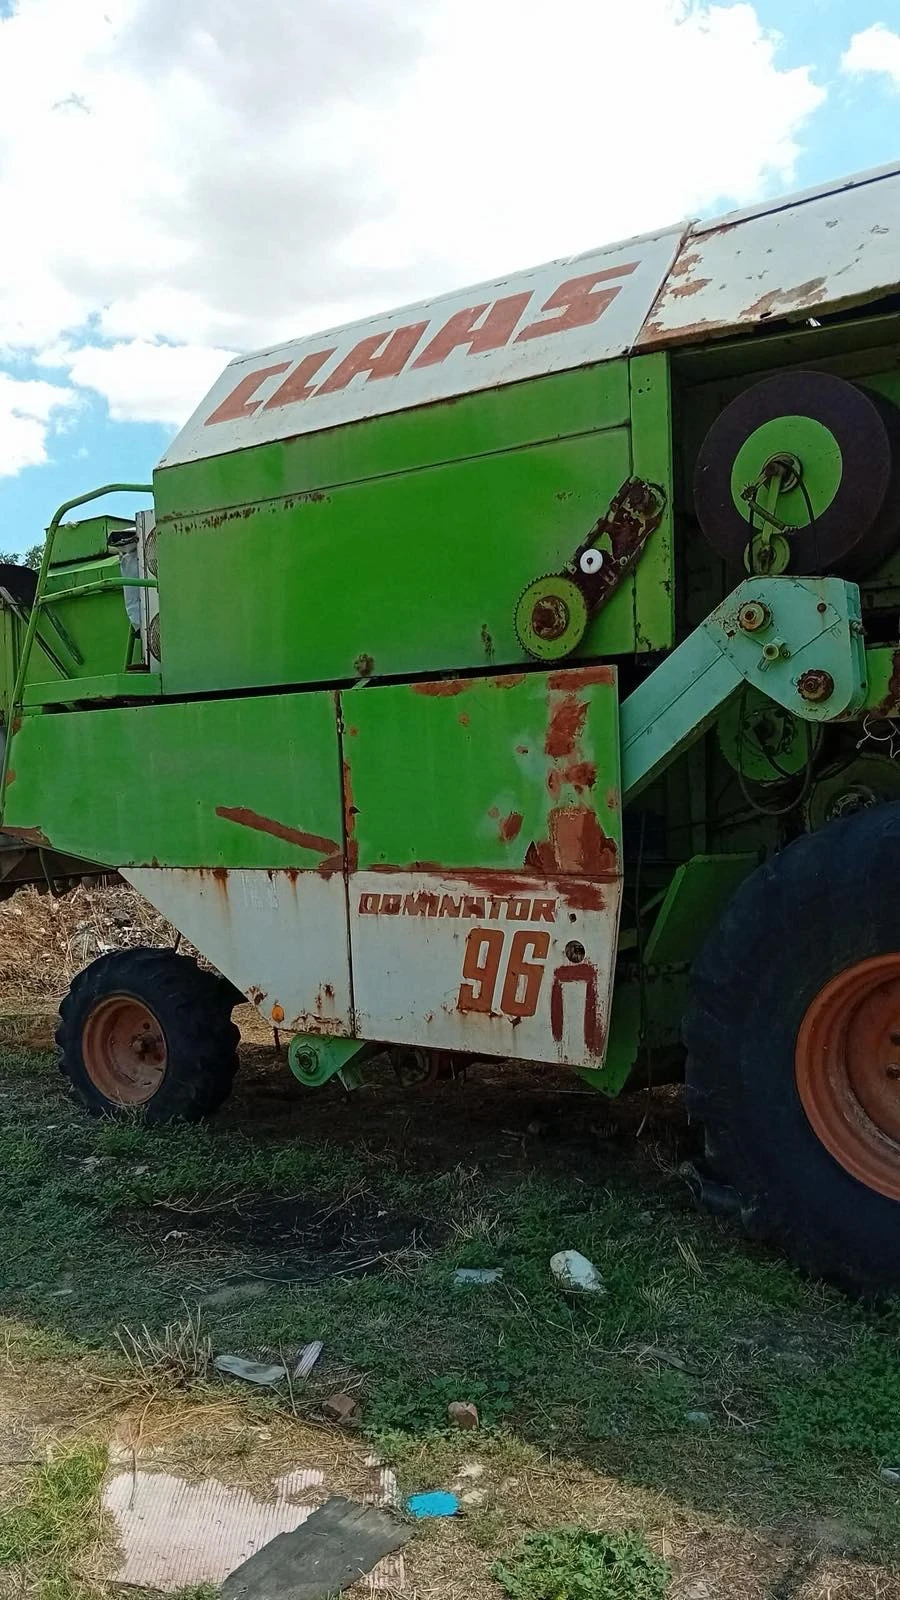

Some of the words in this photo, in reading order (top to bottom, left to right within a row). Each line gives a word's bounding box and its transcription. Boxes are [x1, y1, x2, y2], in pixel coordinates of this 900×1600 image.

[204, 261, 641, 425] CLAAS
[358, 892, 557, 922] DOMINATOR
[457, 927, 550, 1016] 96
